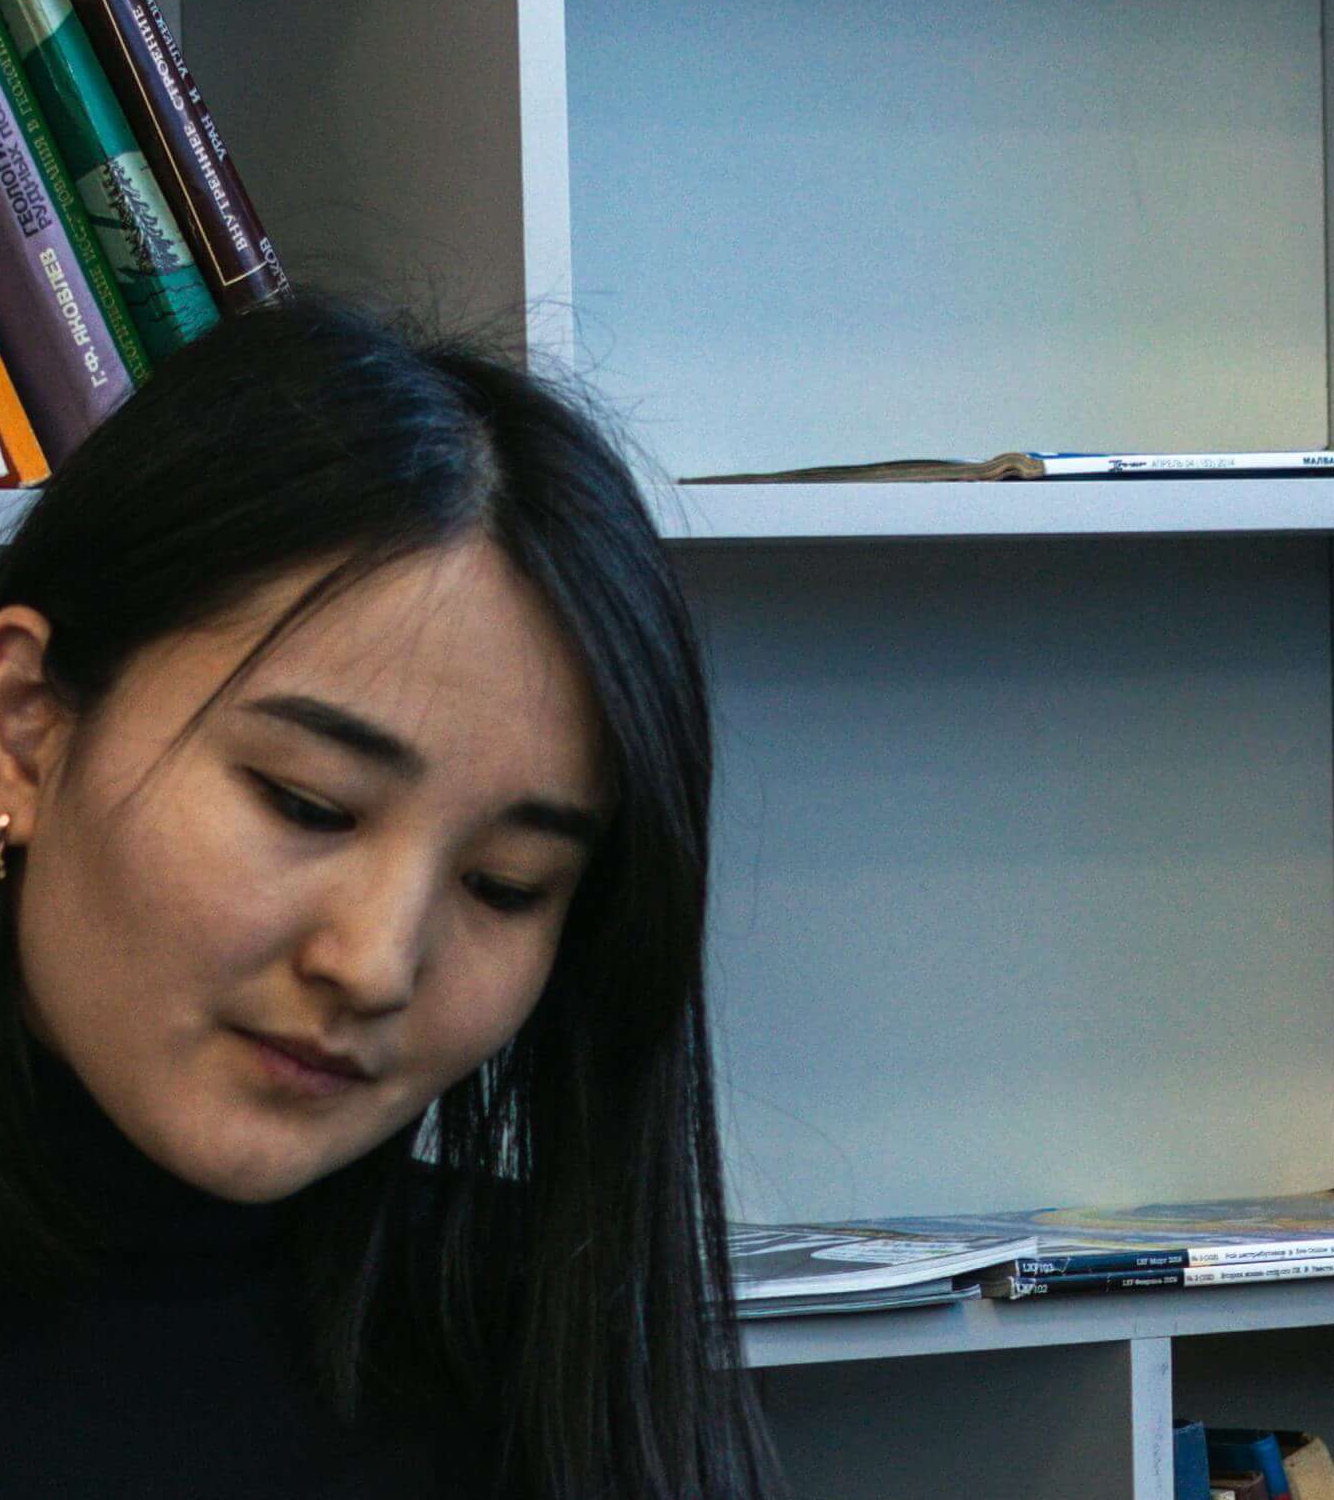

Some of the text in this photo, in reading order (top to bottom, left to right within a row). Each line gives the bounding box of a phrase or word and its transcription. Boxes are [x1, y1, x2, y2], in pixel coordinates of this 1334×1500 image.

[130, 2, 187, 113] СТРОЕНИЕ
[3, 142, 54, 231] РУДНЫХ
[181, 118, 249, 253] ВНУТРЕННЕЕ
[37, 245, 91, 347] ЯКОВЛЕВ
